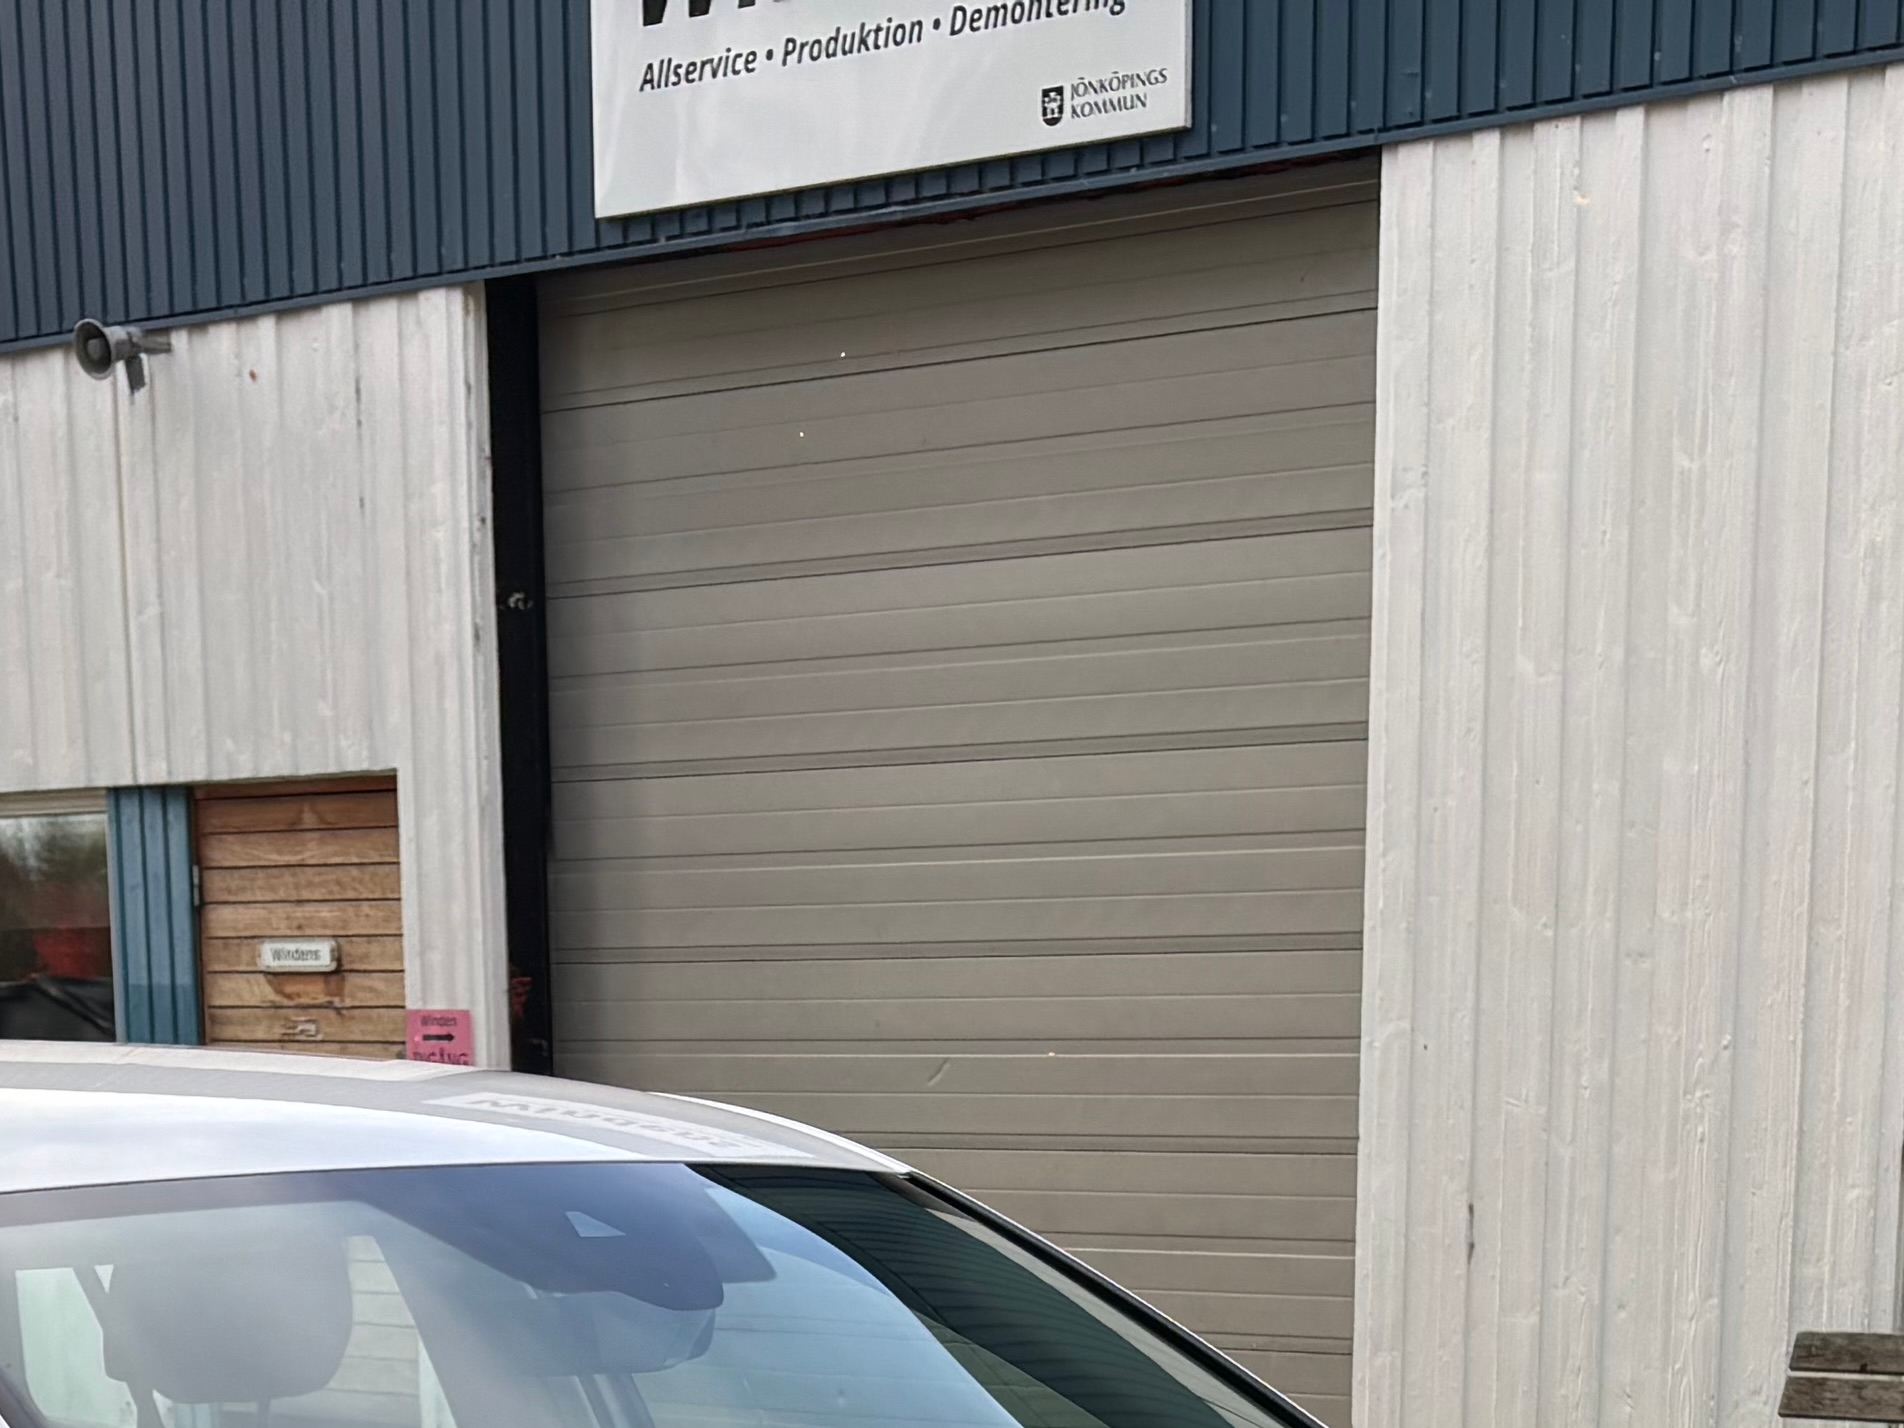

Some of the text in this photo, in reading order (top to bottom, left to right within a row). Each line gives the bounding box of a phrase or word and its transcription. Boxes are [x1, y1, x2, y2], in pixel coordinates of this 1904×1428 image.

[639, 47, 757, 92] Allservice
[781, 17, 924, 67] Produktion
[1070, 92, 1147, 119] KOMMUN
